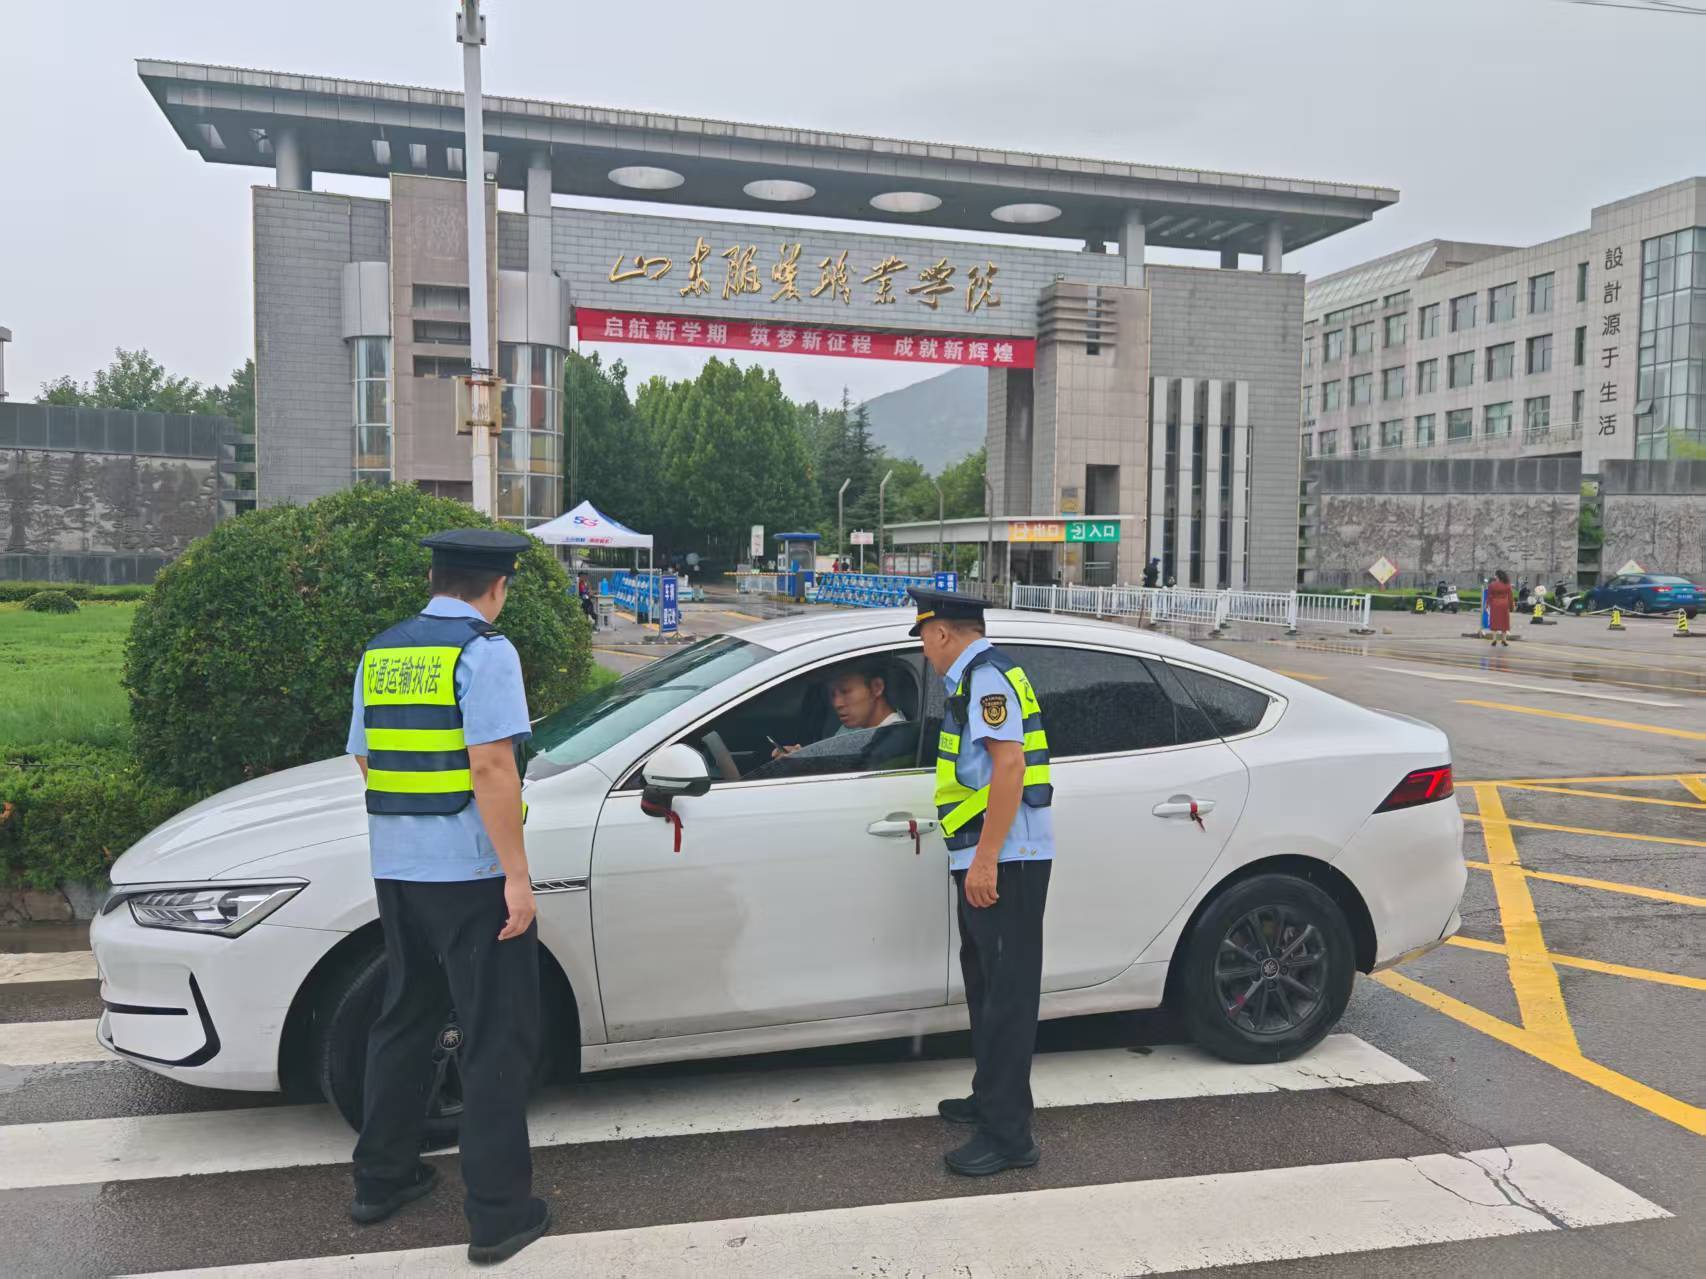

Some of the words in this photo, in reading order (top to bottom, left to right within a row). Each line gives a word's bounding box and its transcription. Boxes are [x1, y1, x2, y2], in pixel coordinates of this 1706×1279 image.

[604, 316, 728, 345] 启航新学期
[750, 327, 872, 354] 筑梦新征程
[894, 337, 1014, 363] 成就新辉煌
[1089, 524, 1115, 537] 入口
